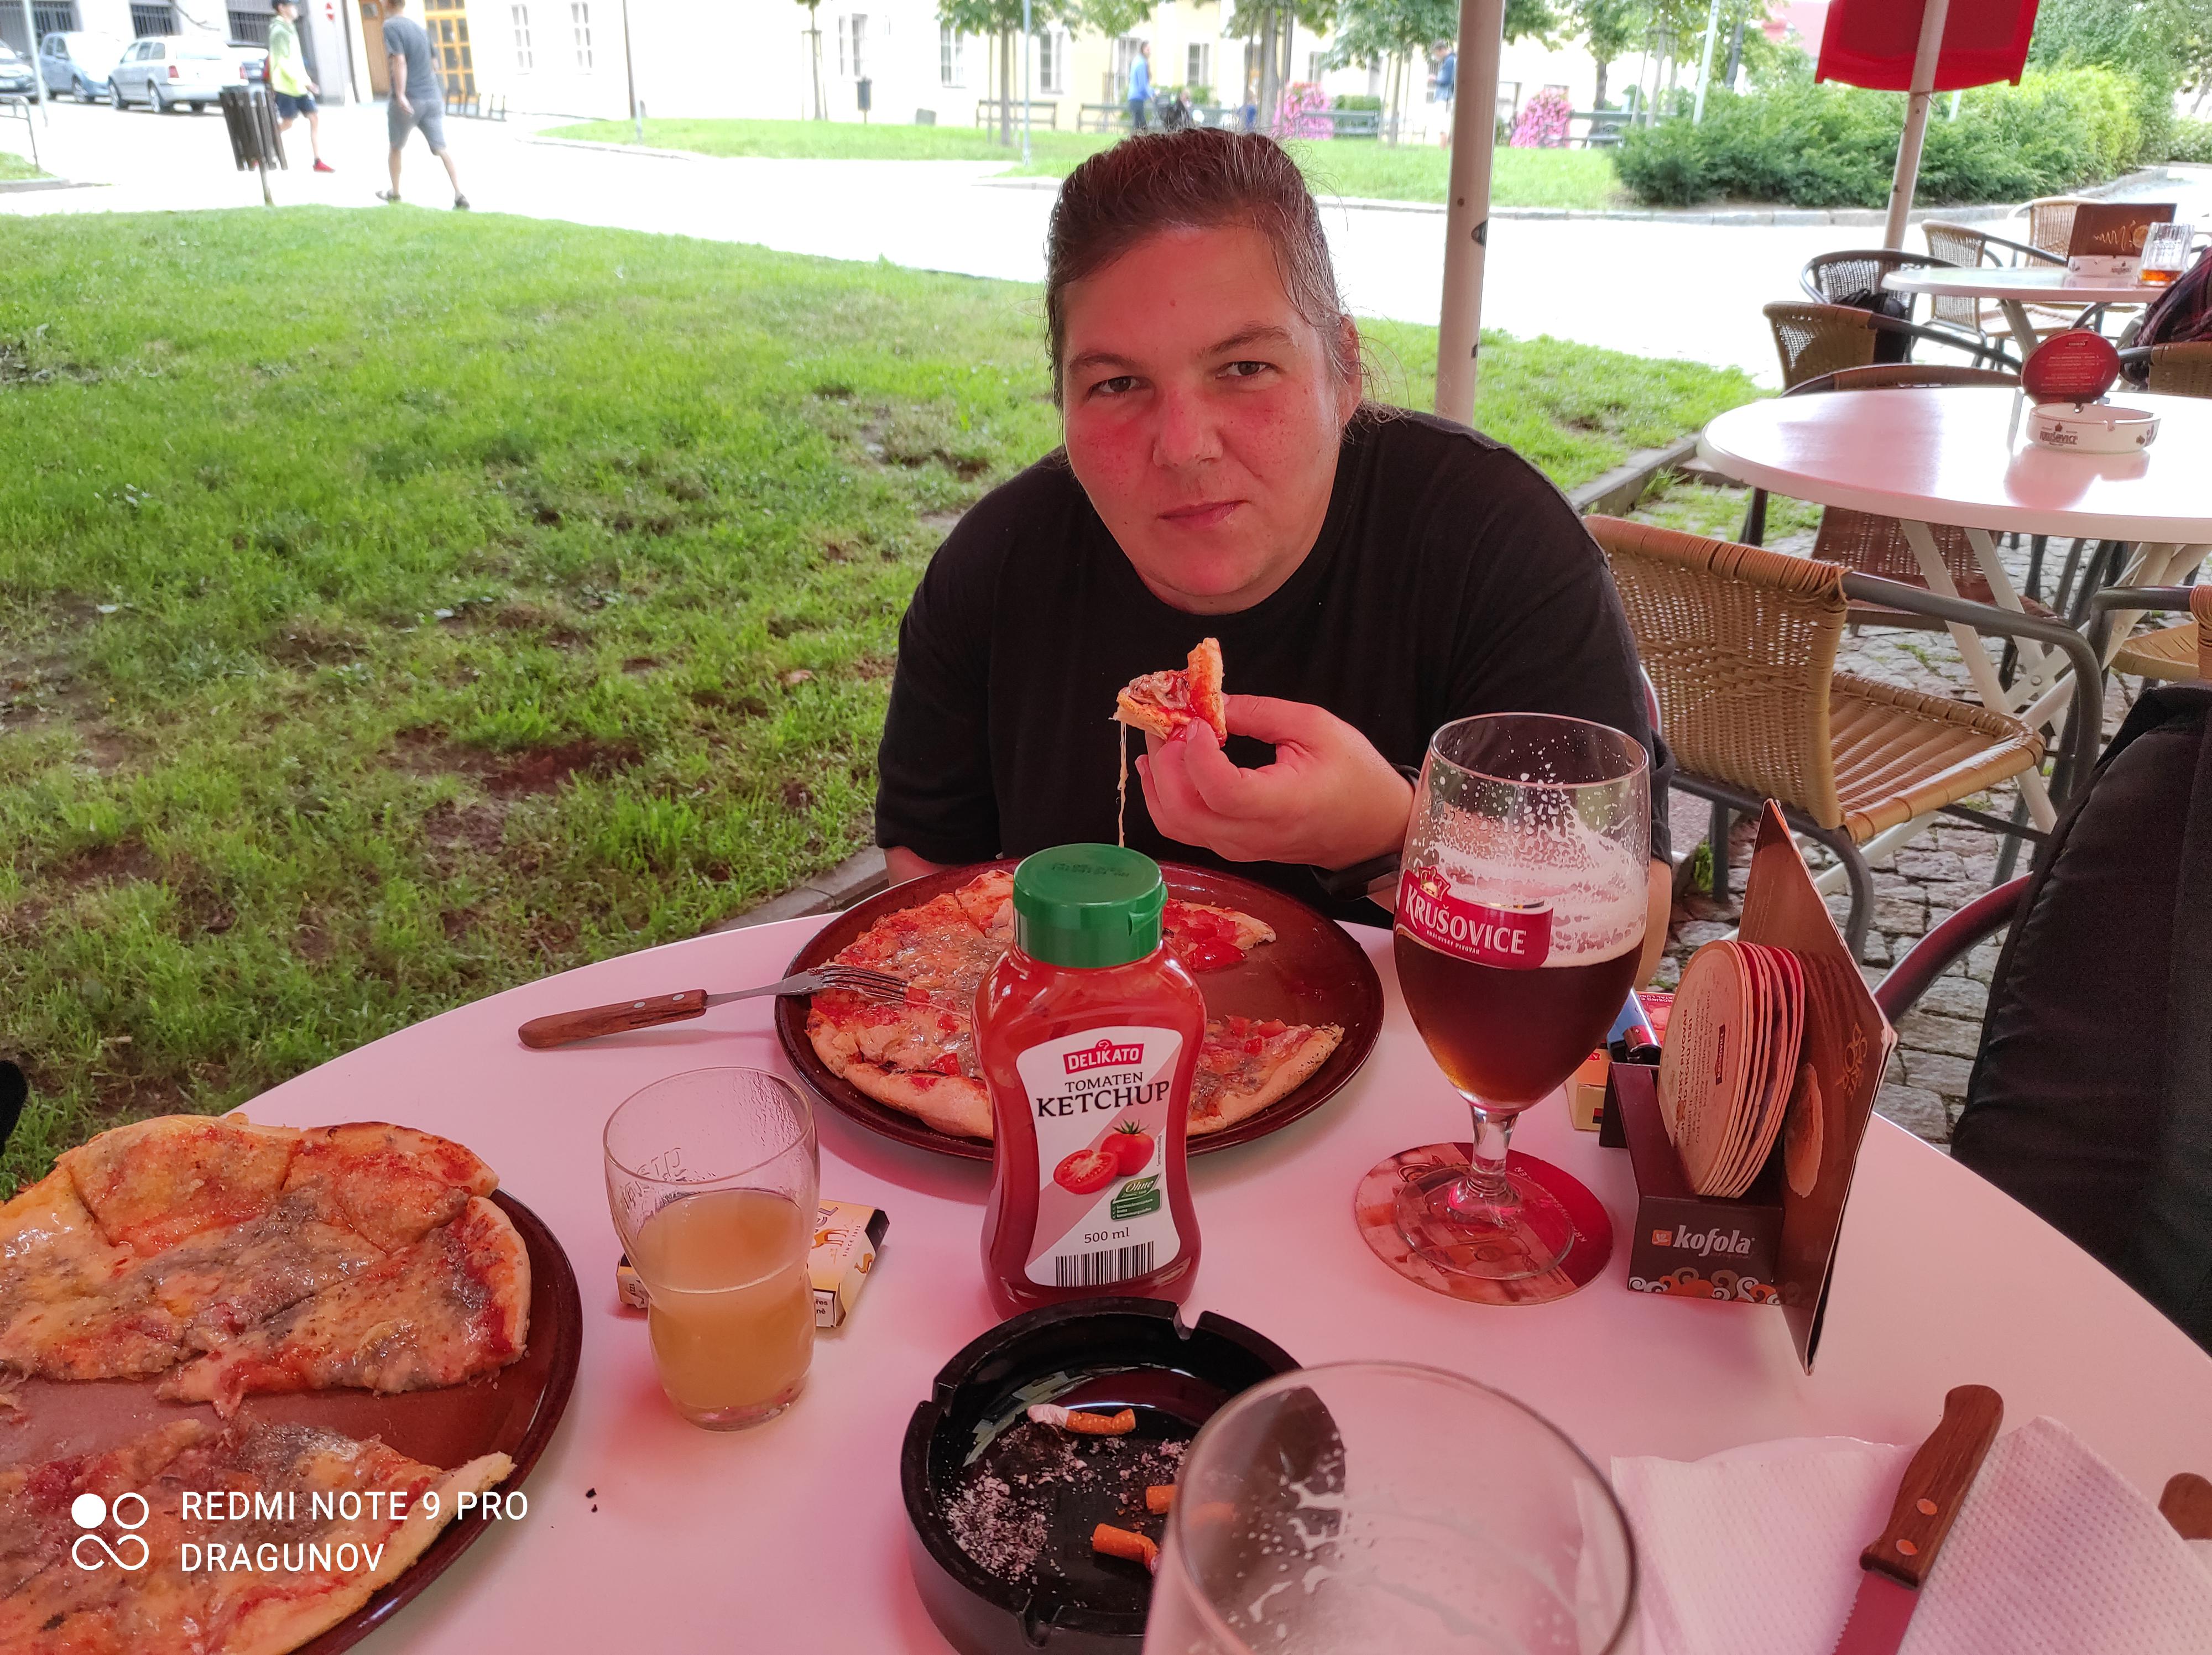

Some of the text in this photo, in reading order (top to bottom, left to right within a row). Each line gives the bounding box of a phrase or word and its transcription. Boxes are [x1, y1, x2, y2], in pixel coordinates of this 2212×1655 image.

[1405, 884, 1526, 955] KRUŠOVICE
[1067, 1048, 1139, 1071] DELIKATO
[1065, 1072, 1142, 1093] TOMATEN
[1036, 1081, 1169, 1117] KETCHUP
[1125, 1181, 1154, 1192] Ohne
[1084, 1227, 1130, 1243] 500 ml
[1673, 1225, 1752, 1256] kofola
[843, 1240, 854, 1257] SINCE
